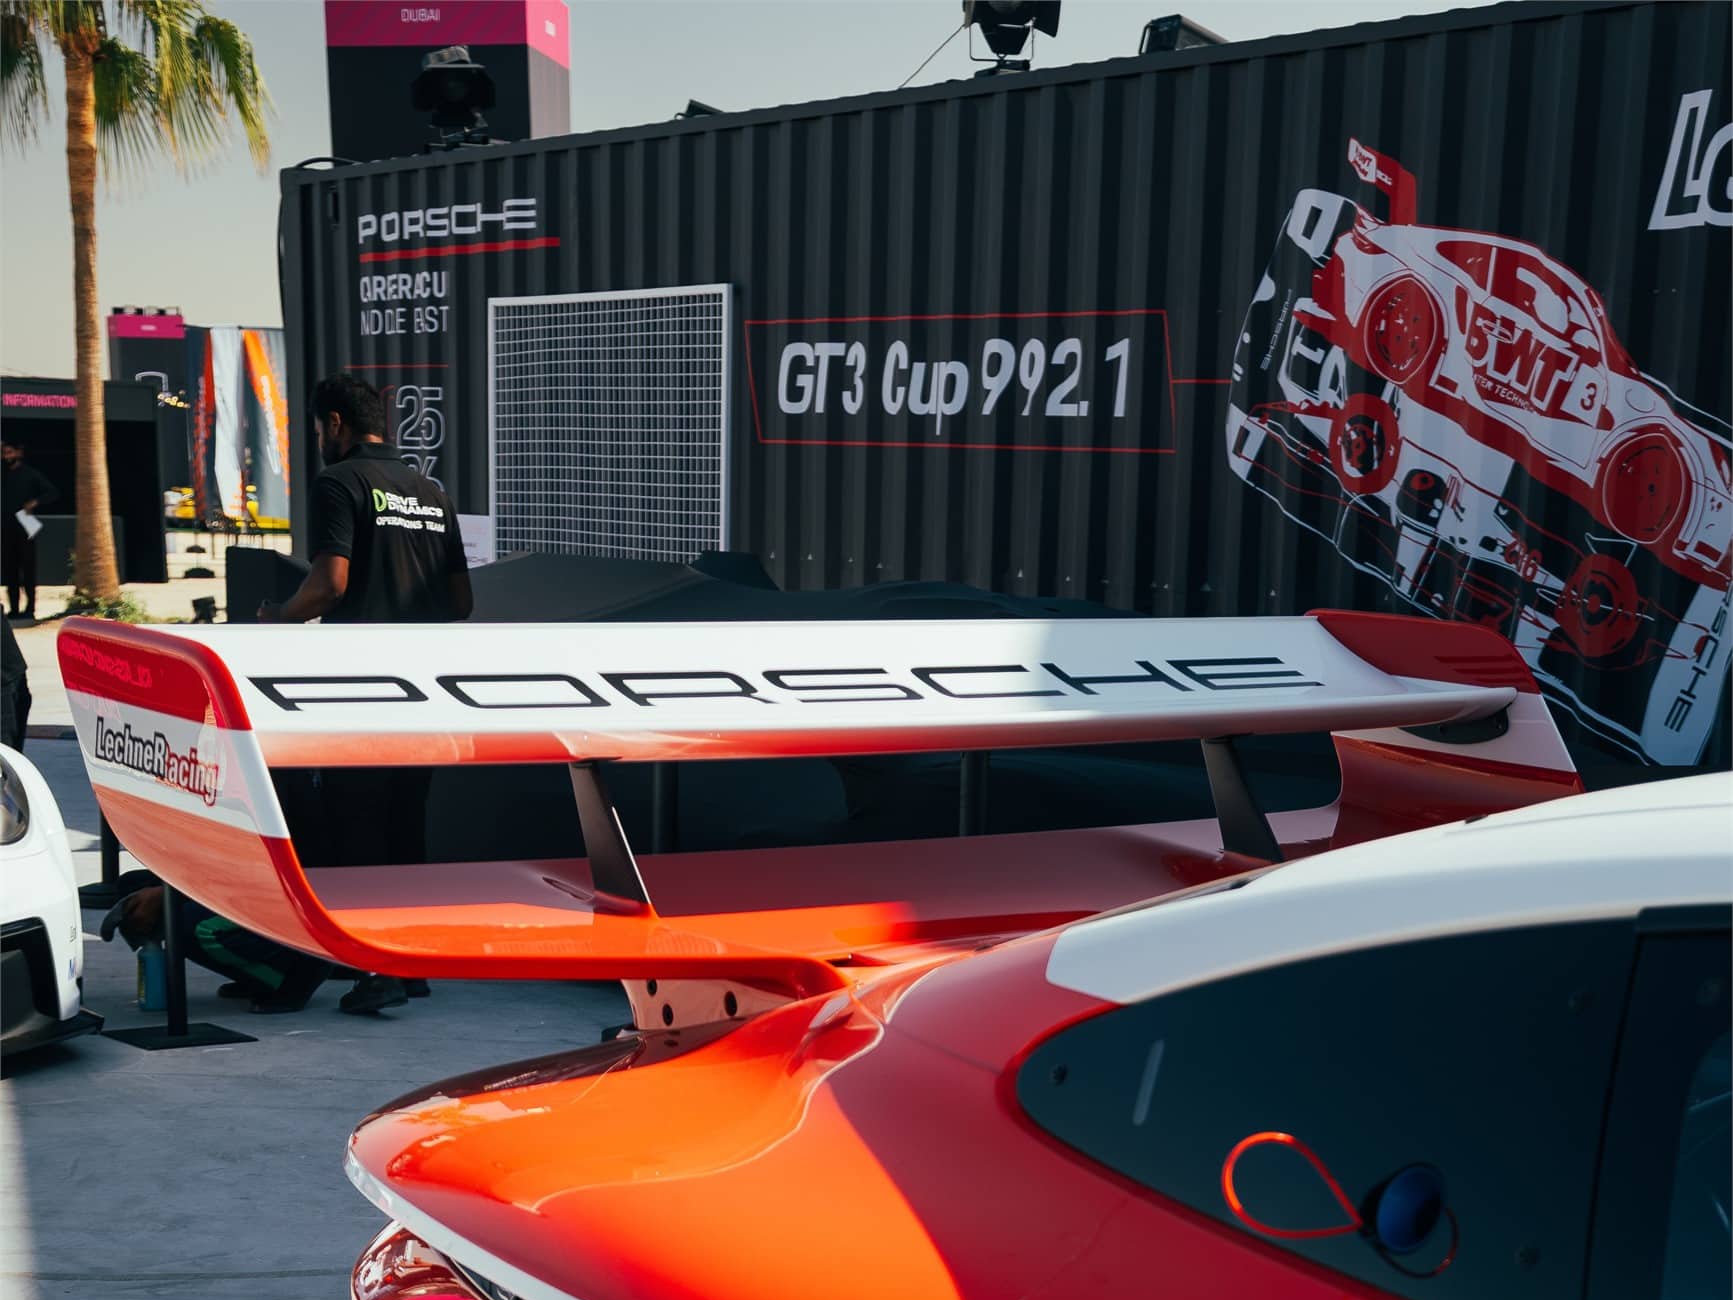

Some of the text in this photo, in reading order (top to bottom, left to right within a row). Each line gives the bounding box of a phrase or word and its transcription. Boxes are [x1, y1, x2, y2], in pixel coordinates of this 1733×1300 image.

[400, 8, 440, 22] DUBAI
[358, 198, 537, 244] PORSCHE
[2, 393, 78, 408] INFORMATION
[778, 338, 1130, 435] GT3 Cup 992.1
[1579, 382, 1598, 411] 3
[396, 385, 446, 450] 25
[376, 516, 445, 533] OPERATIONS TEAM
[247, 656, 1326, 711] PORSCHE
